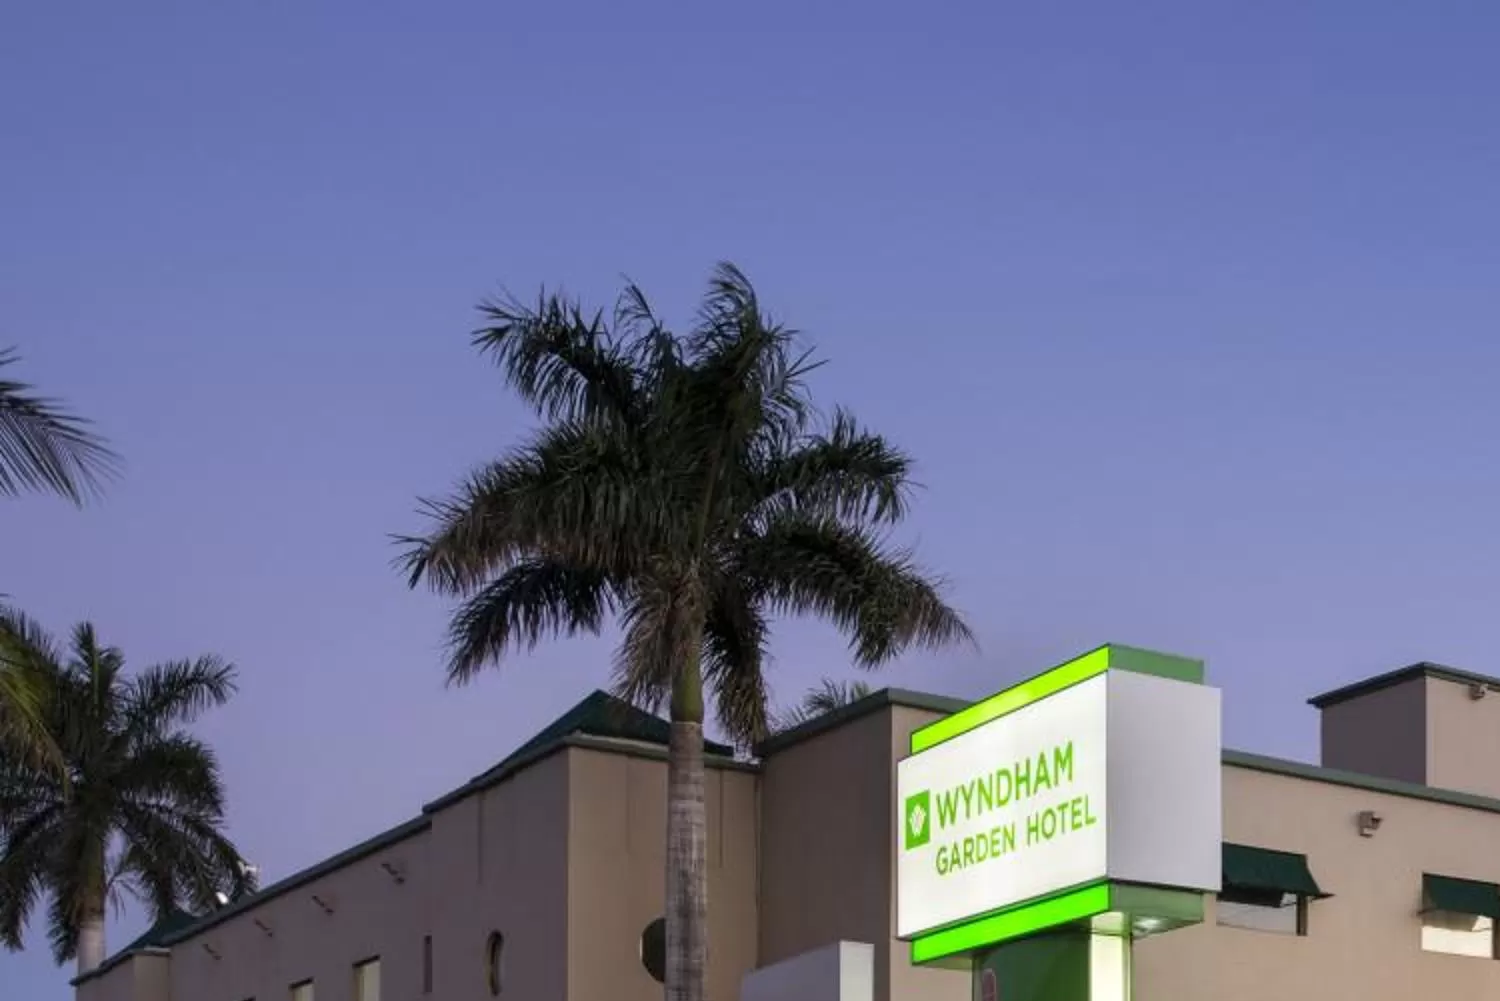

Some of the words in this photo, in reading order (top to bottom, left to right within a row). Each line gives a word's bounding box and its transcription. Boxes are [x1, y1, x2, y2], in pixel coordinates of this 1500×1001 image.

[935, 740, 1073, 829] WYNDHAM
[935, 823, 1016, 876] GARDEN
[1026, 794, 1097, 846] HOTEL
